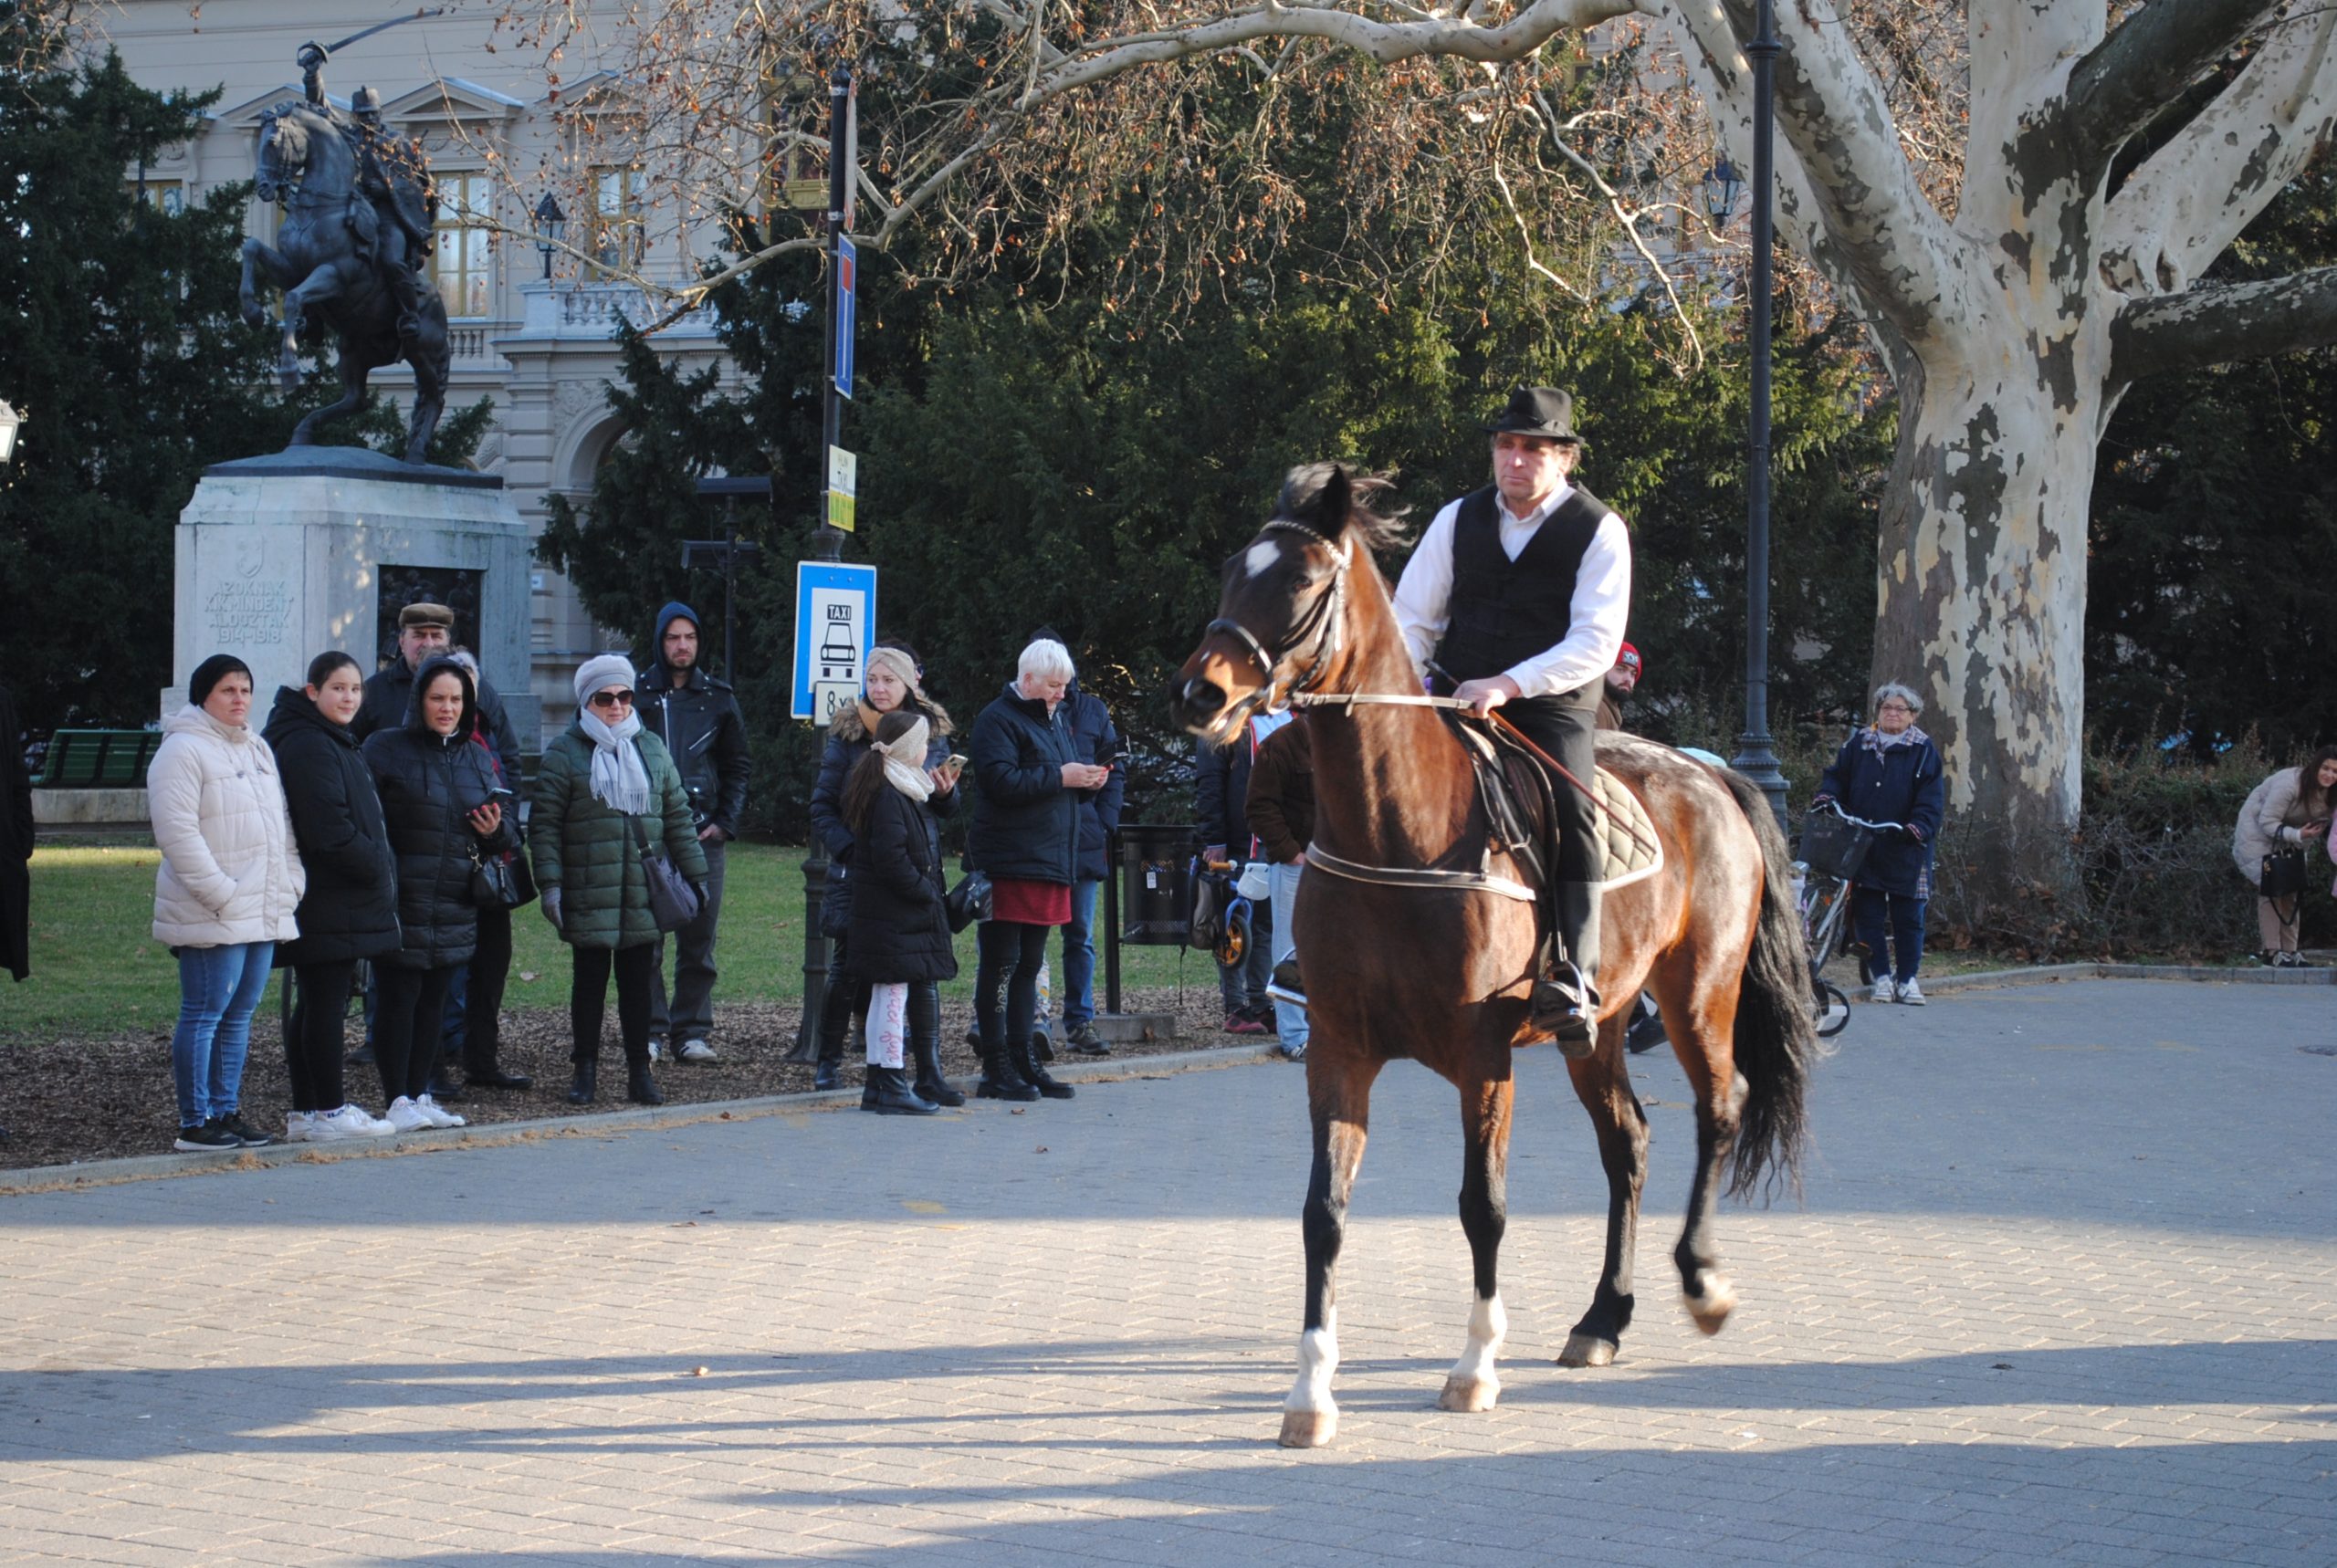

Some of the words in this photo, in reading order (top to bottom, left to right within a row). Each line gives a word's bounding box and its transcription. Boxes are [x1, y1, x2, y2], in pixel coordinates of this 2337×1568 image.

[215, 580, 285, 596] AZOKNAK
[204, 595, 229, 612] KIK
[230, 595, 294, 612] MINDENT
[828, 606, 851, 620] TAXI
[216, 628, 282, 648] 1914-1918
[827, 691, 835, 716] 8
